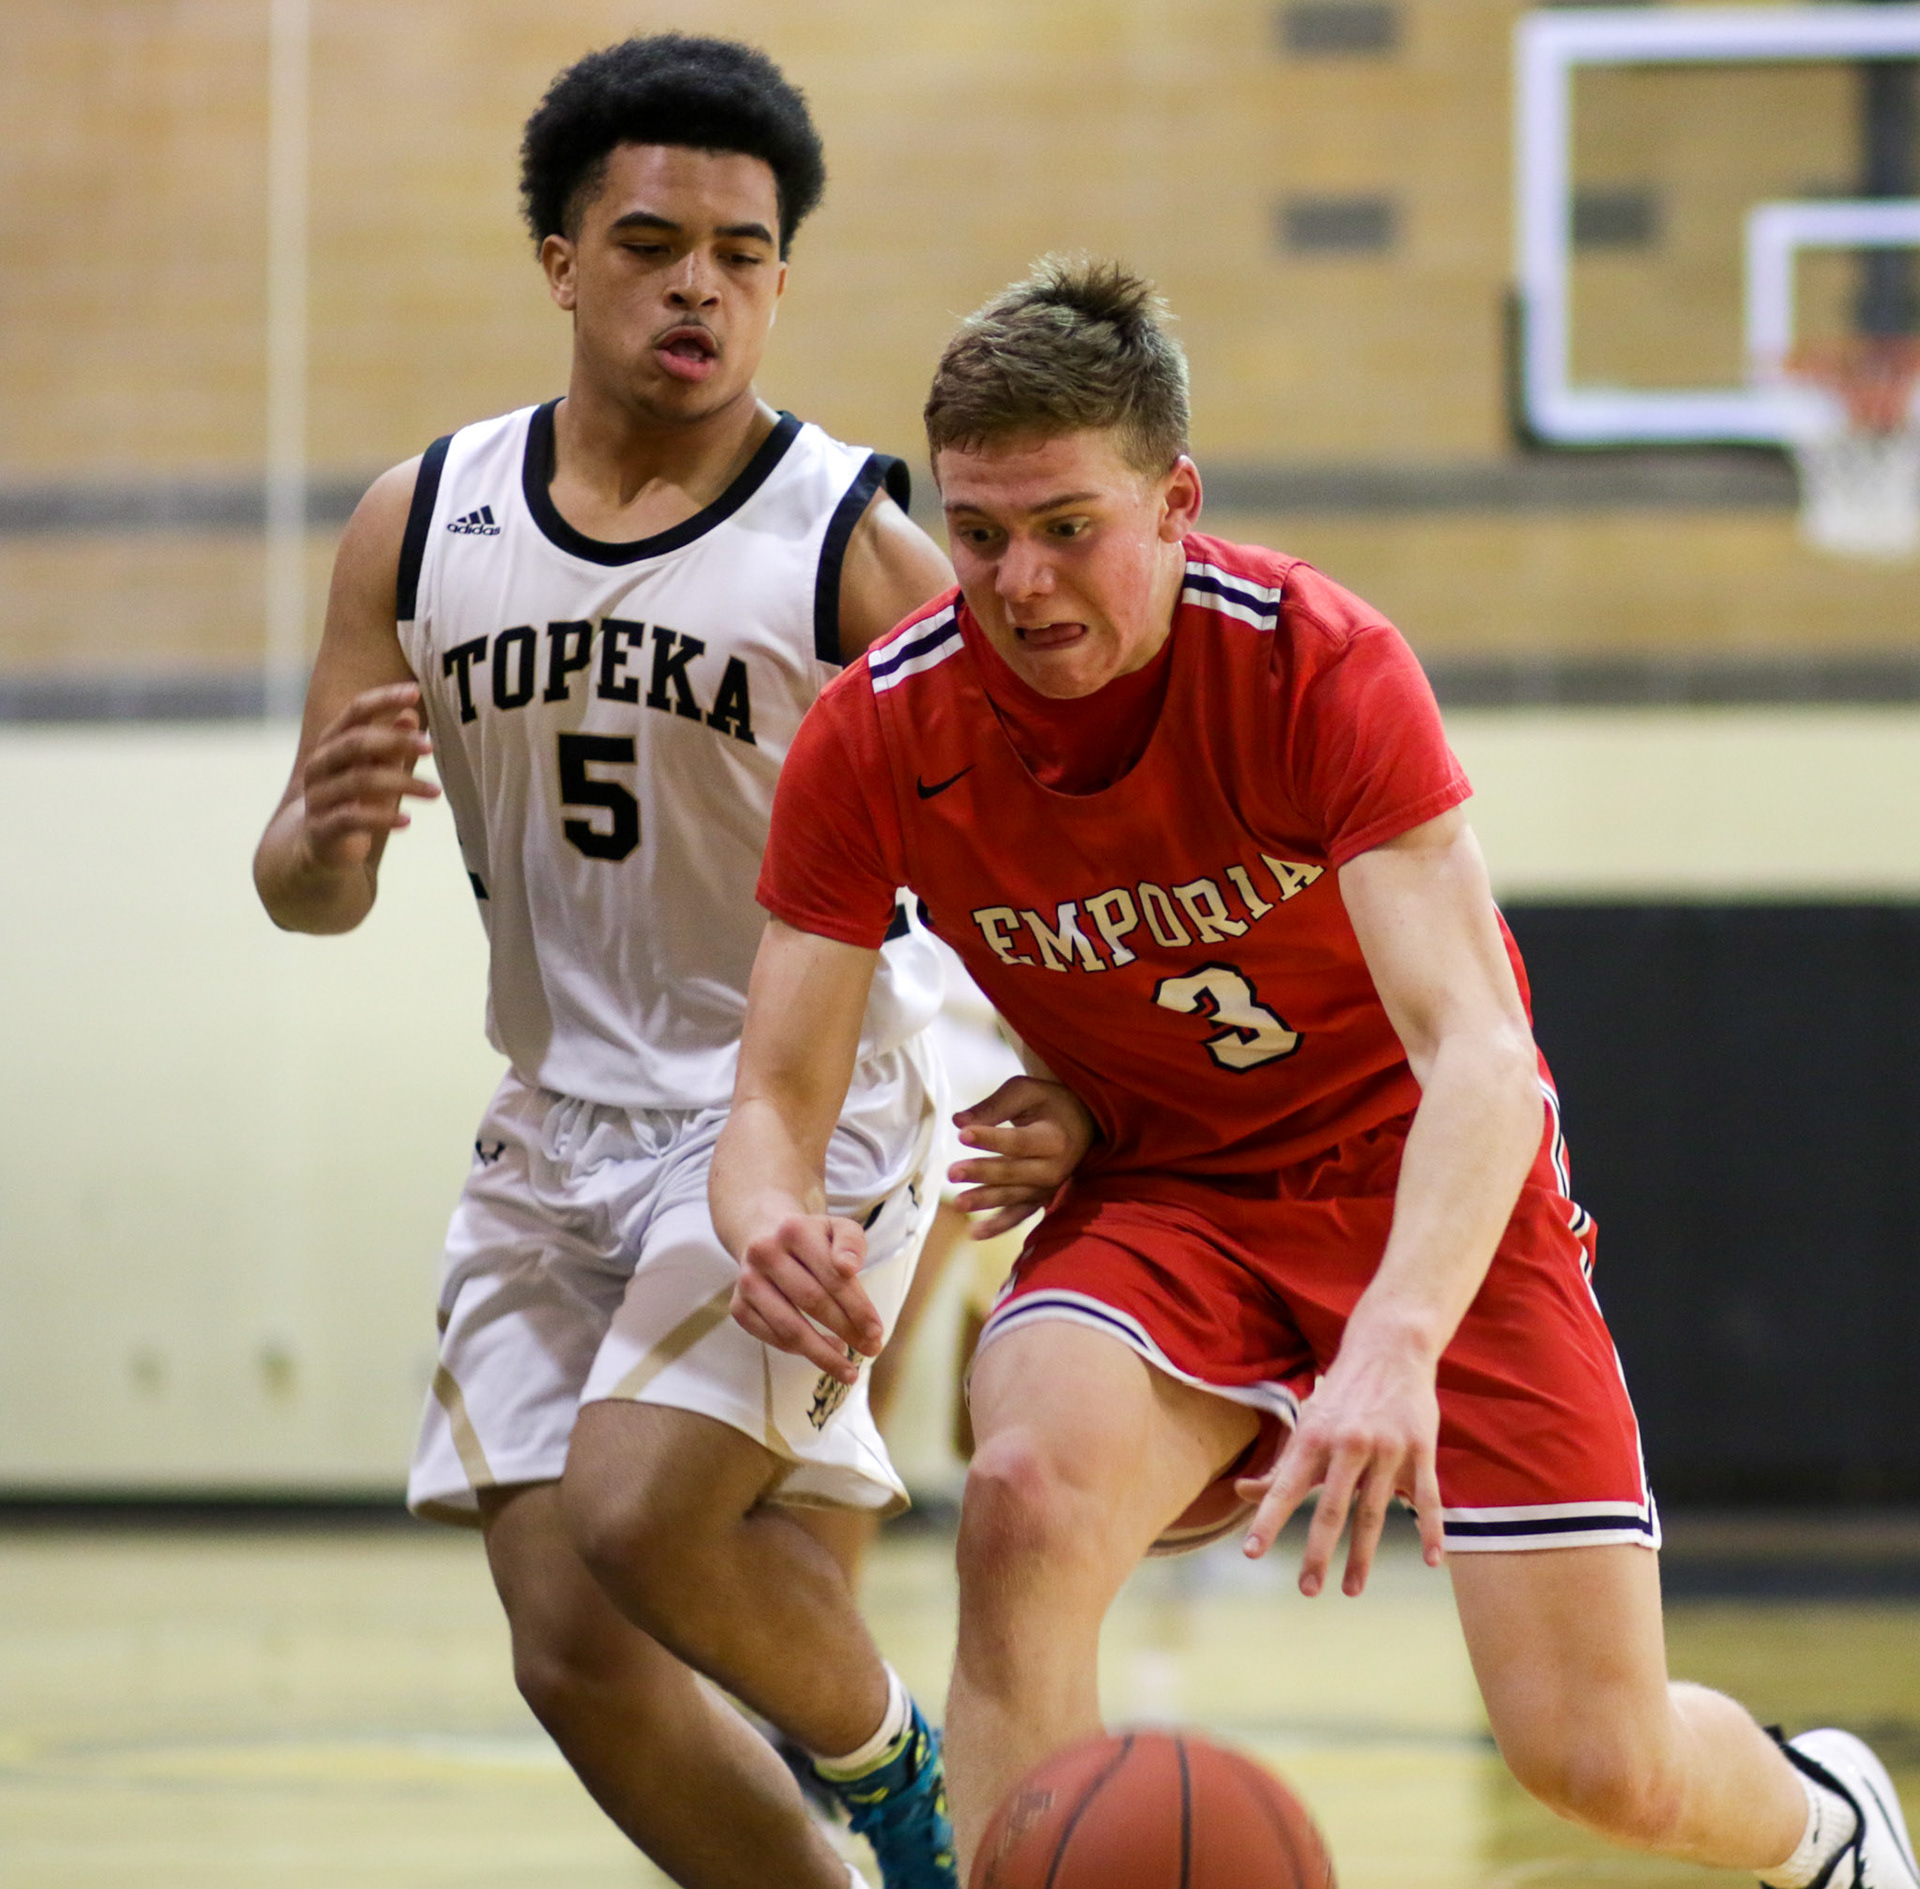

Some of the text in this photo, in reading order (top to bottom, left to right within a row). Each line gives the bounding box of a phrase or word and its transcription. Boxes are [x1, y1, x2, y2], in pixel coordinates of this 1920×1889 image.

[447, 523, 501, 536] adidas
[443, 617, 757, 746] TOPEKA
[557, 731, 641, 863] 5
[971, 853, 1326, 973] EMPORIA
[1151, 961, 1305, 1075] 3
